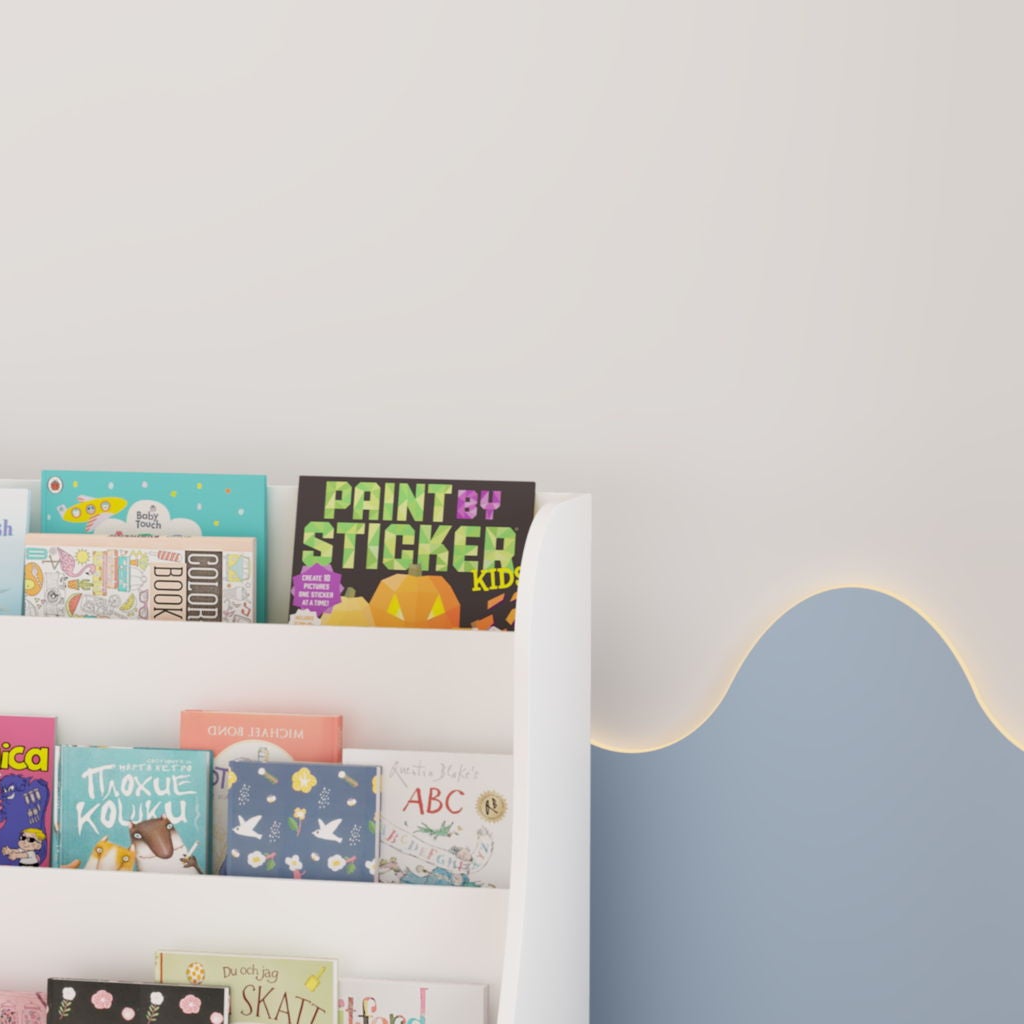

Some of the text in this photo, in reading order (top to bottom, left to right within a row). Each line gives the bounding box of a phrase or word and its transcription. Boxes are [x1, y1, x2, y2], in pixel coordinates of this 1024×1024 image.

[324, 481, 502, 522] PAINT BY
[136, 511, 158, 521] Baby
[136, 520, 161, 529] Touch
[302, 521, 517, 573] STICKER
[187, 554, 219, 619] COLOR
[302, 574, 322, 582] CREATE
[154, 567, 183, 619] BOOK
[402, 787, 465, 815] ABC
[222, 964, 279, 983] Du och jag
